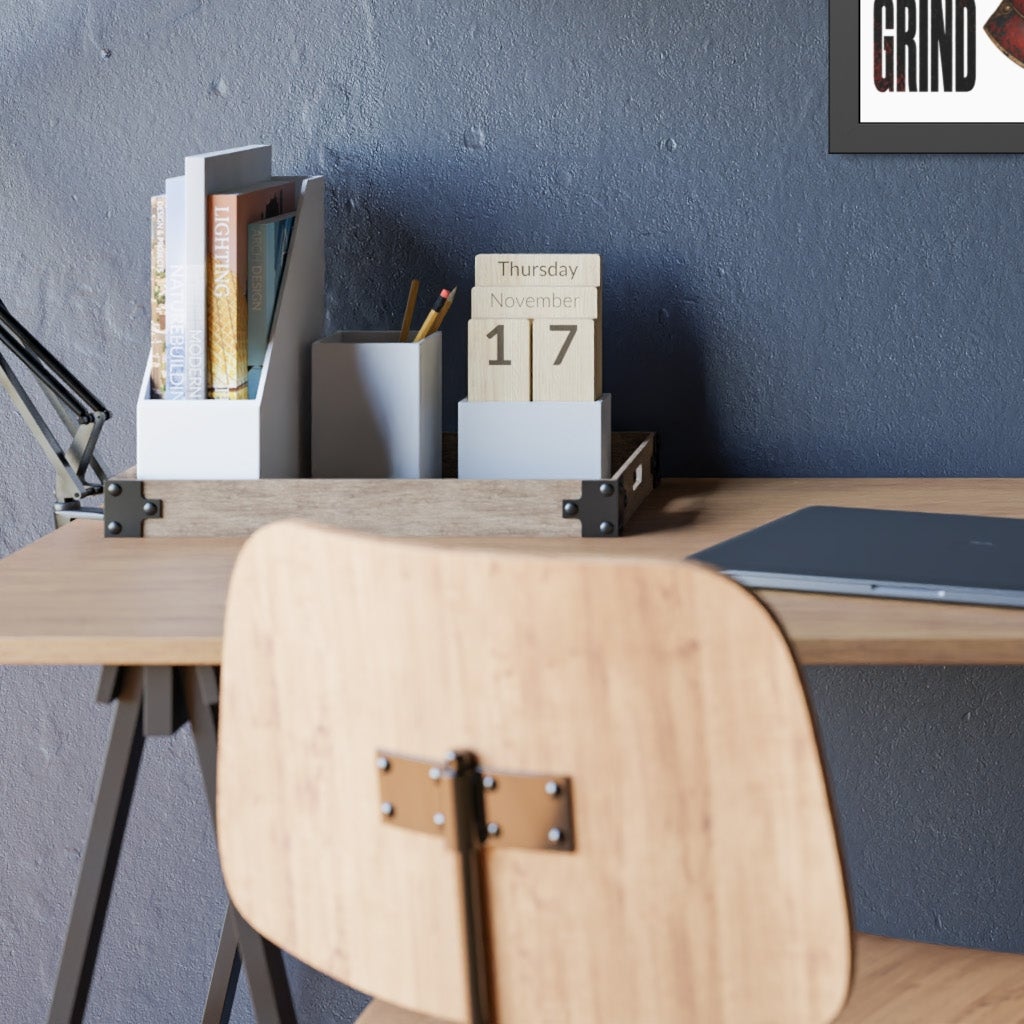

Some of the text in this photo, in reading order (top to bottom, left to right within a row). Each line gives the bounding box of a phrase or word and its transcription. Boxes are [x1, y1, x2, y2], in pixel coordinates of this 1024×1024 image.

[213, 206, 230, 298] LIGHTING
[498, 261, 579, 280] Thursday
[252, 265, 263, 311] DESIGN
[490, 292, 580, 309] November
[188, 329, 203, 398] MODERN
